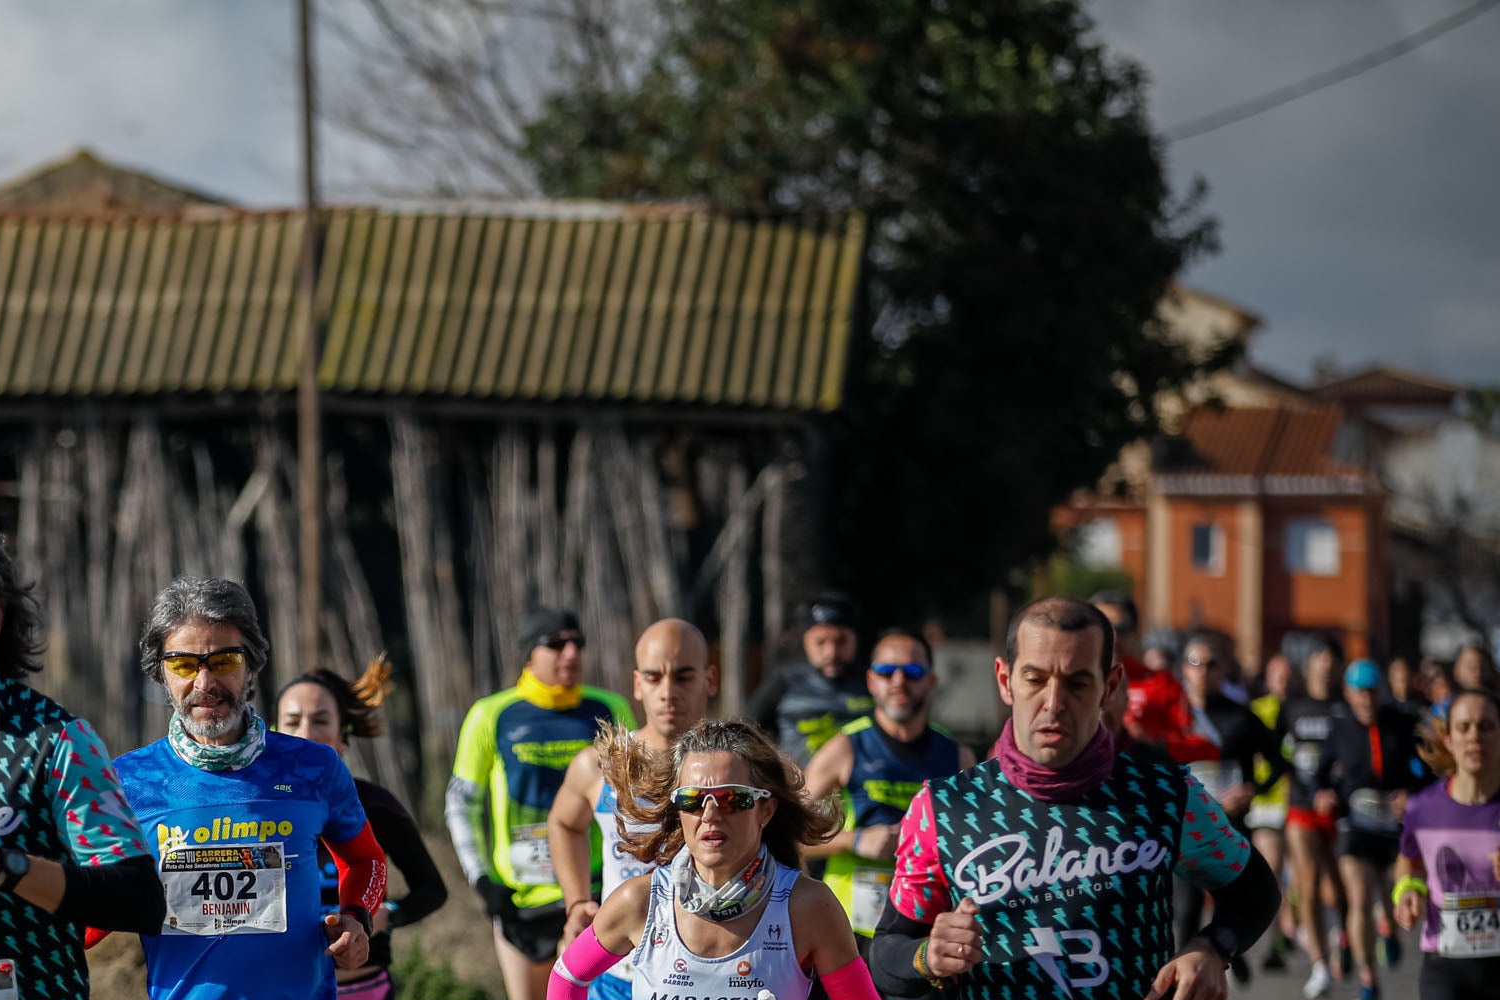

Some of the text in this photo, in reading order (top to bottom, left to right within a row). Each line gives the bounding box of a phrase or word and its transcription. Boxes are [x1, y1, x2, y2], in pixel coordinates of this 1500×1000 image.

[194, 817, 293, 843] olimpo
[165, 852, 177, 860] 26
[954, 826, 1168, 905] Balance
[191, 871, 257, 901] 402
[1008, 896, 1039, 908] GYM
[202, 902, 251, 916] BENJAMIN
[663, 979, 694, 987] GARRIDO
[729, 977, 765, 990] mayfo
